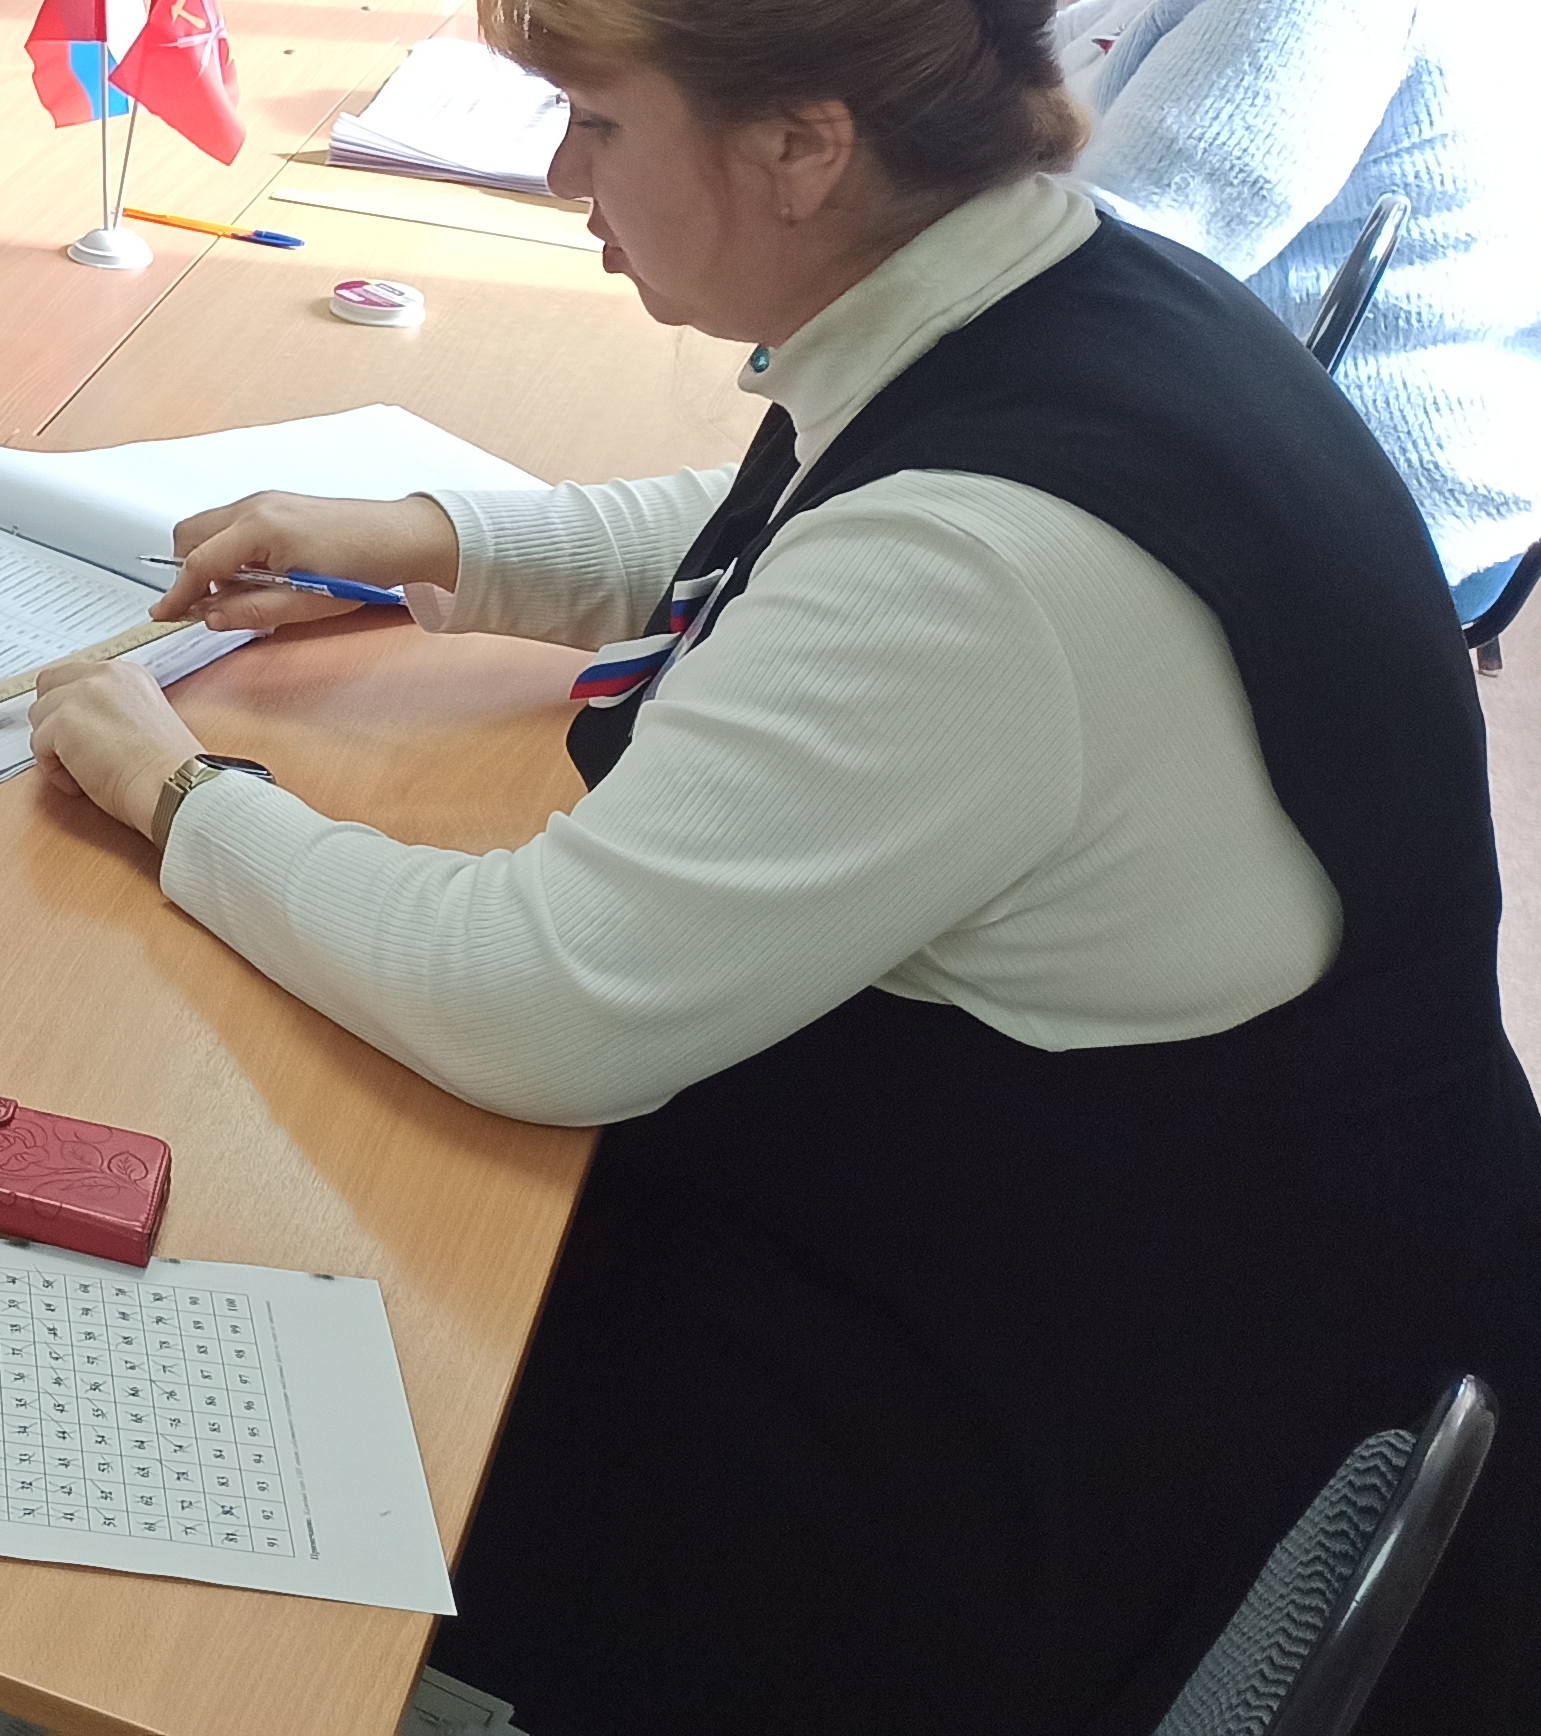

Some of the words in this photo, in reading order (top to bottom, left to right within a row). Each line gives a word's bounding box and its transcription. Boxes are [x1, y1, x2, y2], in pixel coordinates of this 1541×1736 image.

[188, 1295, 200, 1306] 90
[224, 1297, 238, 1311] 100
[192, 1319, 204, 1330] 89
[229, 1324, 241, 1335] 99
[196, 1344, 208, 1355] 88
[233, 1348, 246, 1359] 98
[200, 1369, 212, 1380] 87
[238, 1373, 251, 1385] 97
[203, 1395, 216, 1406] 86
[242, 1399, 255, 1411] 96
[208, 1421, 221, 1433] 85
[246, 1425, 260, 1437] 95
[212, 1447, 225, 1459] 84
[251, 1452, 264, 1464] 94
[216, 1475, 229, 1487] 83
[255, 1480, 269, 1492] 93
[260, 1508, 274, 1521] 92
[265, 1535, 279, 1549] 91
